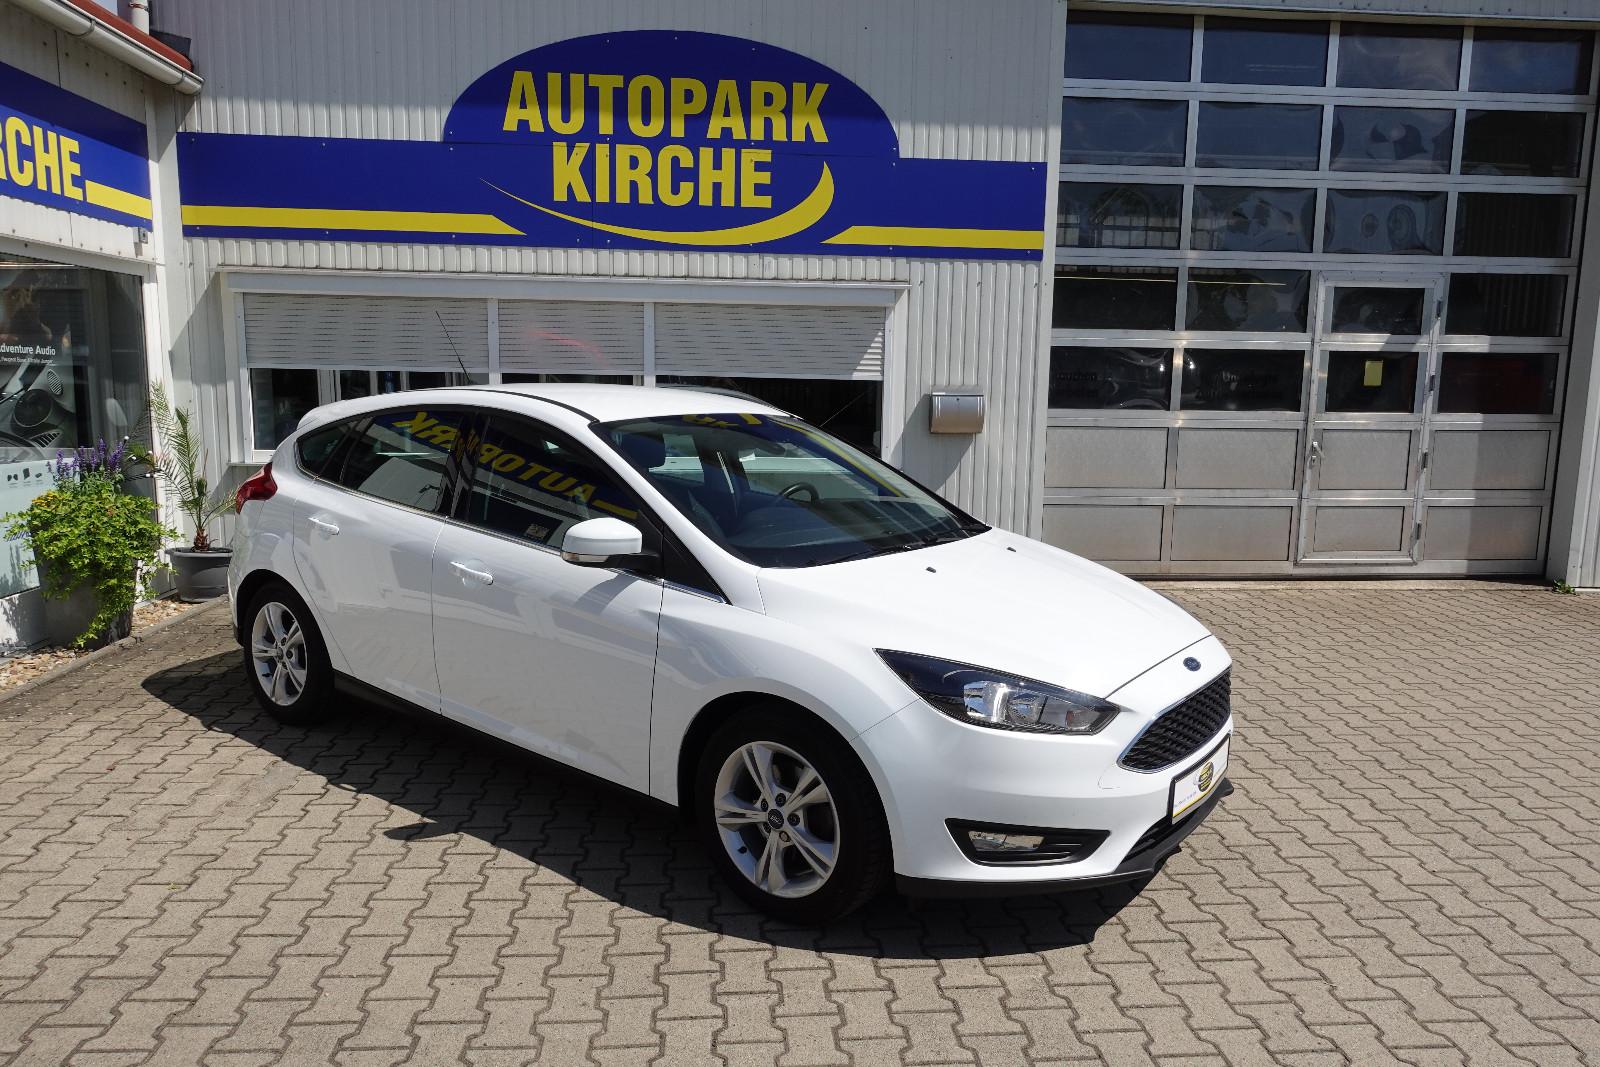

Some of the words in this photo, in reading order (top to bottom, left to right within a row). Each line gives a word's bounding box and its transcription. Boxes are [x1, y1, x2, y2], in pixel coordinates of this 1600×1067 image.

[502, 70, 829, 143] AUTOPARK
[552, 141, 773, 209] KIRCHE
[35, 345, 56, 355] Audio
